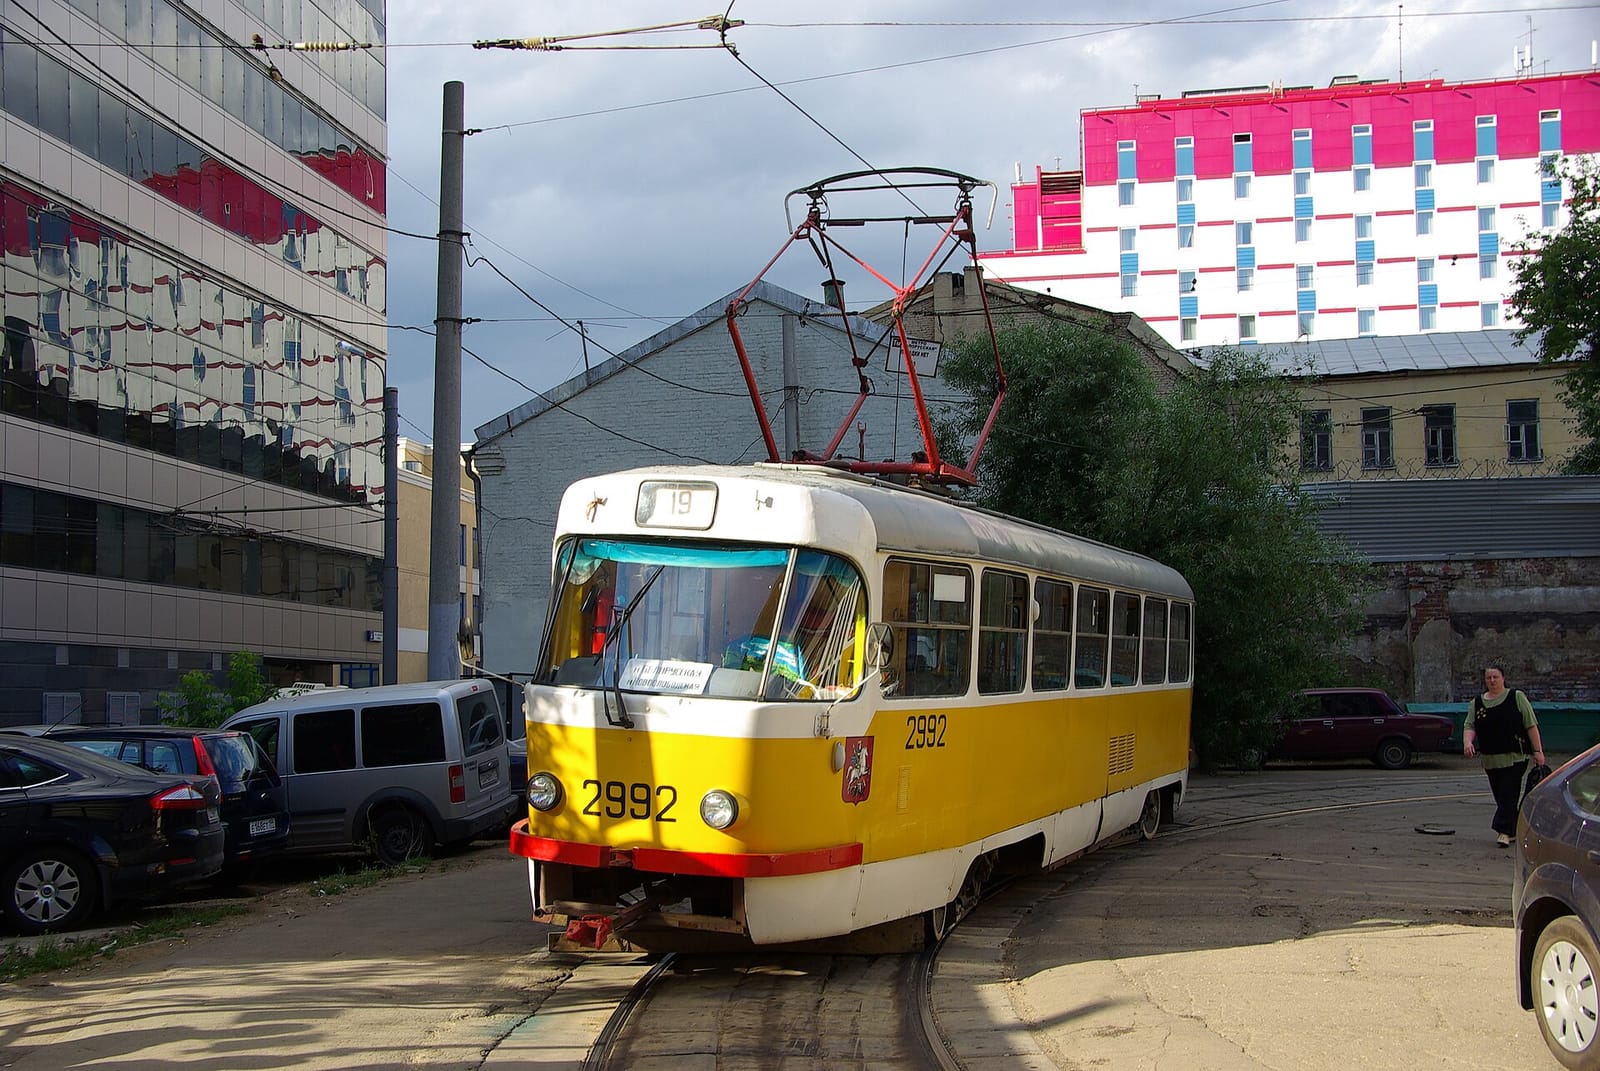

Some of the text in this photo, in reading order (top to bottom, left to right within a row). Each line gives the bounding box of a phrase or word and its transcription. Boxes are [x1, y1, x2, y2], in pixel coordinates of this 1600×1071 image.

[671, 490, 692, 515] 19
[905, 714, 947, 750] 2992
[582, 779, 678, 823] 2992
